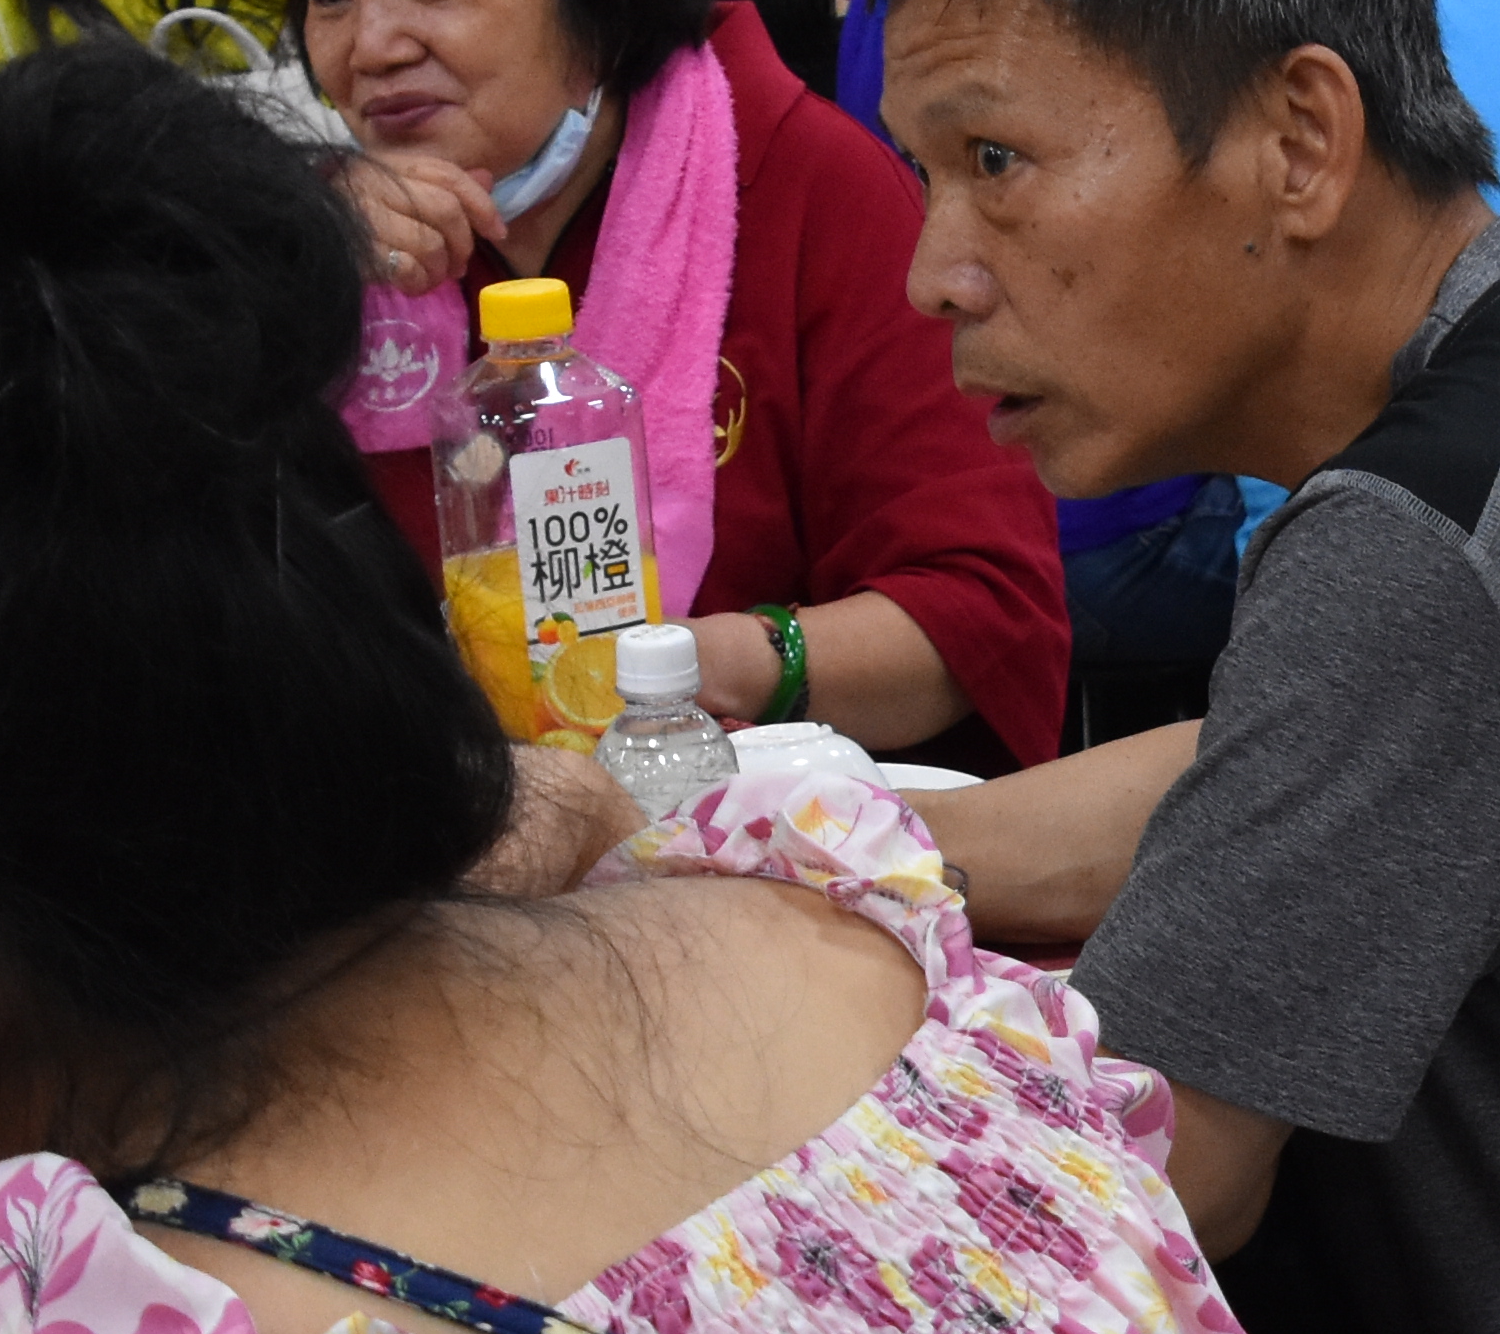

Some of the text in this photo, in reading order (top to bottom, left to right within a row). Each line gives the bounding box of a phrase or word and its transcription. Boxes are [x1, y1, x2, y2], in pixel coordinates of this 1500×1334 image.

[543, 479, 611, 507] 果汁時刻
[527, 503, 629, 550] 100%
[530, 538, 635, 604] 柳橙
